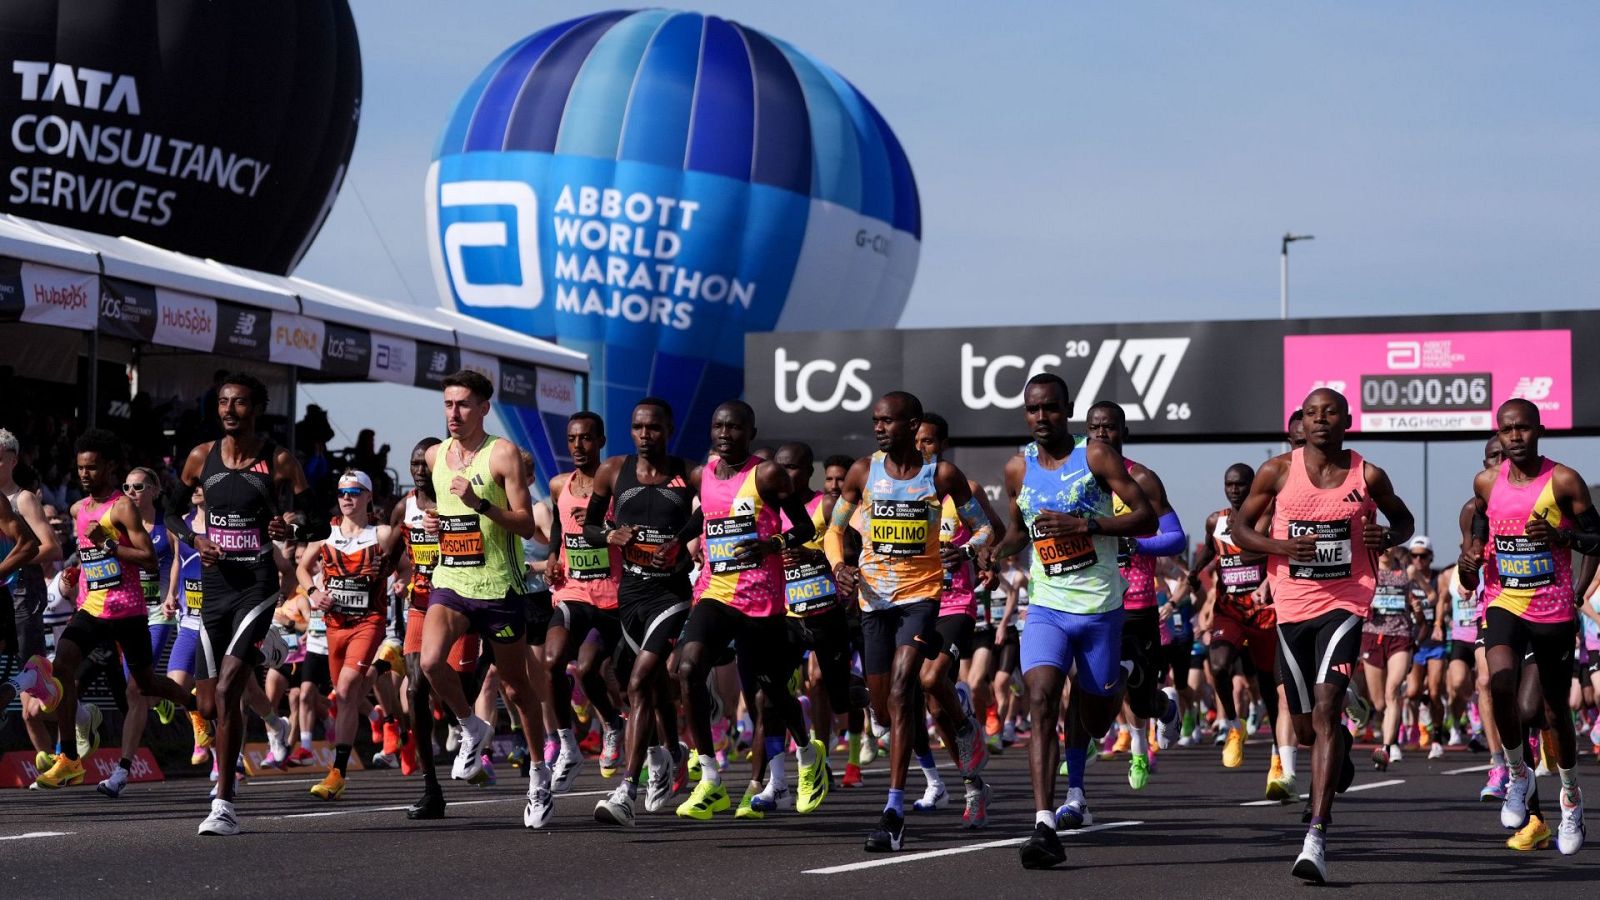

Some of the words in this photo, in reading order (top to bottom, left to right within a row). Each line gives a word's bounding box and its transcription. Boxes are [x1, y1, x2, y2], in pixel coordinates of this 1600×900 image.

[13, 60, 141, 115] TATA
[11, 115, 271, 197] CONSULTANCY
[9, 166, 176, 225] SERVICES
[554, 184, 700, 230] ABBOTT
[554, 216, 682, 259] WORLD
[554, 254, 756, 309] MARATHON
[34, 284, 88, 310] HubSpot
[555, 286, 694, 330] MAJORS
[162, 306, 212, 334] HubSpot
[275, 326, 318, 351] FLORA
[327, 335, 345, 358] tcs
[1066, 340, 1090, 357] 20
[503, 372, 516, 393] tcs
[774, 348, 872, 412] tcs
[540, 383, 571, 401] HubSpot
[1363, 378, 1487, 406] 00:00:06
[1166, 403, 1191, 420] 26
[874, 502, 895, 517] tcs
[210, 512, 227, 526] tcs
[724, 522, 752, 530] CONSULTANCY
[707, 521, 724, 536] tcs
[873, 526, 925, 540] KIPLIMO
[1289, 522, 1314, 538] tcs
[210, 533, 258, 548] KEJELCHA
[410, 531, 424, 543] tcs
[566, 536, 578, 548] tcs
[1496, 537, 1515, 551] tcs
[710, 542, 735, 559] PAC
[1040, 538, 1092, 561] GOBENA
[1315, 548, 1343, 562] AWE
[570, 555, 600, 567] TOLA
[1073, 560, 1093, 569] balance
[1221, 556, 1234, 567] tcs
[1501, 559, 1531, 575] PACE
[1533, 559, 1549, 572] 11
[84, 566, 105, 579] PACE
[105, 563, 118, 575] 10
[784, 570, 801, 580] tcs
[186, 580, 198, 590] tcs
[330, 577, 343, 588] tcs
[1530, 579, 1551, 587] balance
[331, 593, 364, 605] SMITH
[788, 581, 821, 601] PACE
